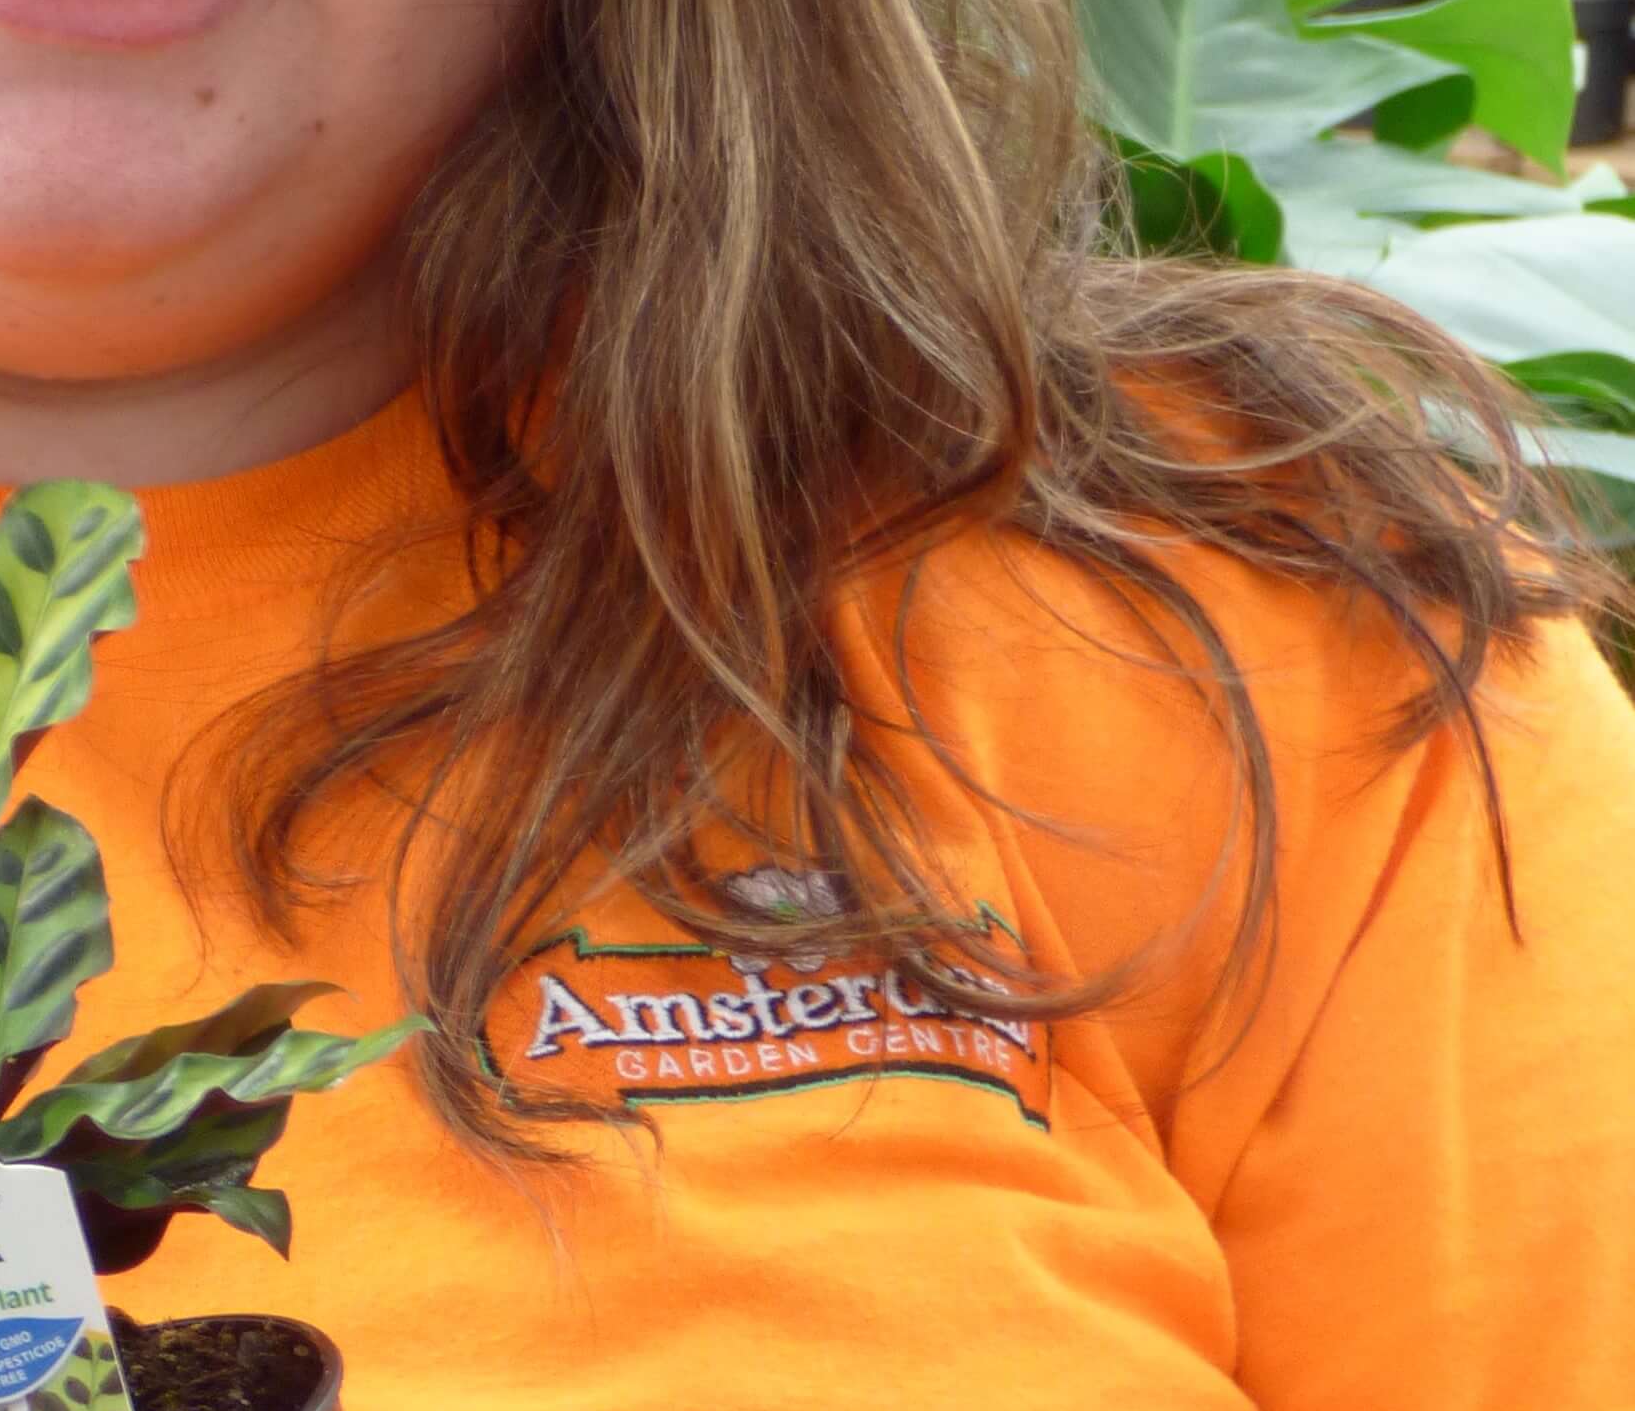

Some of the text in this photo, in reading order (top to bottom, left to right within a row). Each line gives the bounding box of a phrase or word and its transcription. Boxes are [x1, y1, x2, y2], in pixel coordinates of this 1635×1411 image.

[526, 966, 1033, 1059] Amsterd
[614, 1021, 1012, 1081] GARDEN CENTRE
